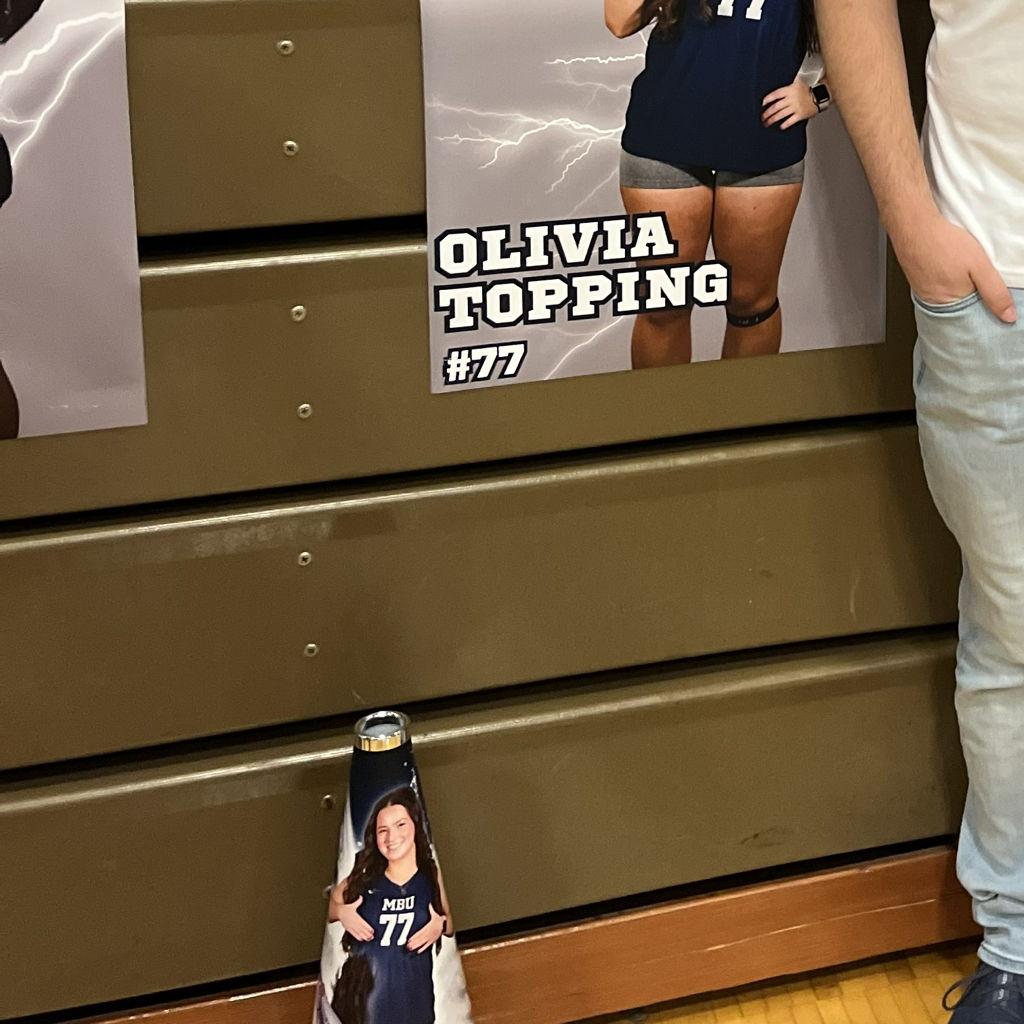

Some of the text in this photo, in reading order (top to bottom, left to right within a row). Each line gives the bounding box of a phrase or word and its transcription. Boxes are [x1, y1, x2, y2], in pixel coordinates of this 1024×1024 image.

[436, 213, 677, 277] OLIVIA
[436, 261, 730, 331] TOPPING
[444, 341, 527, 384] #77
[381, 895, 415, 912] MBU
[379, 912, 415, 947] 77
